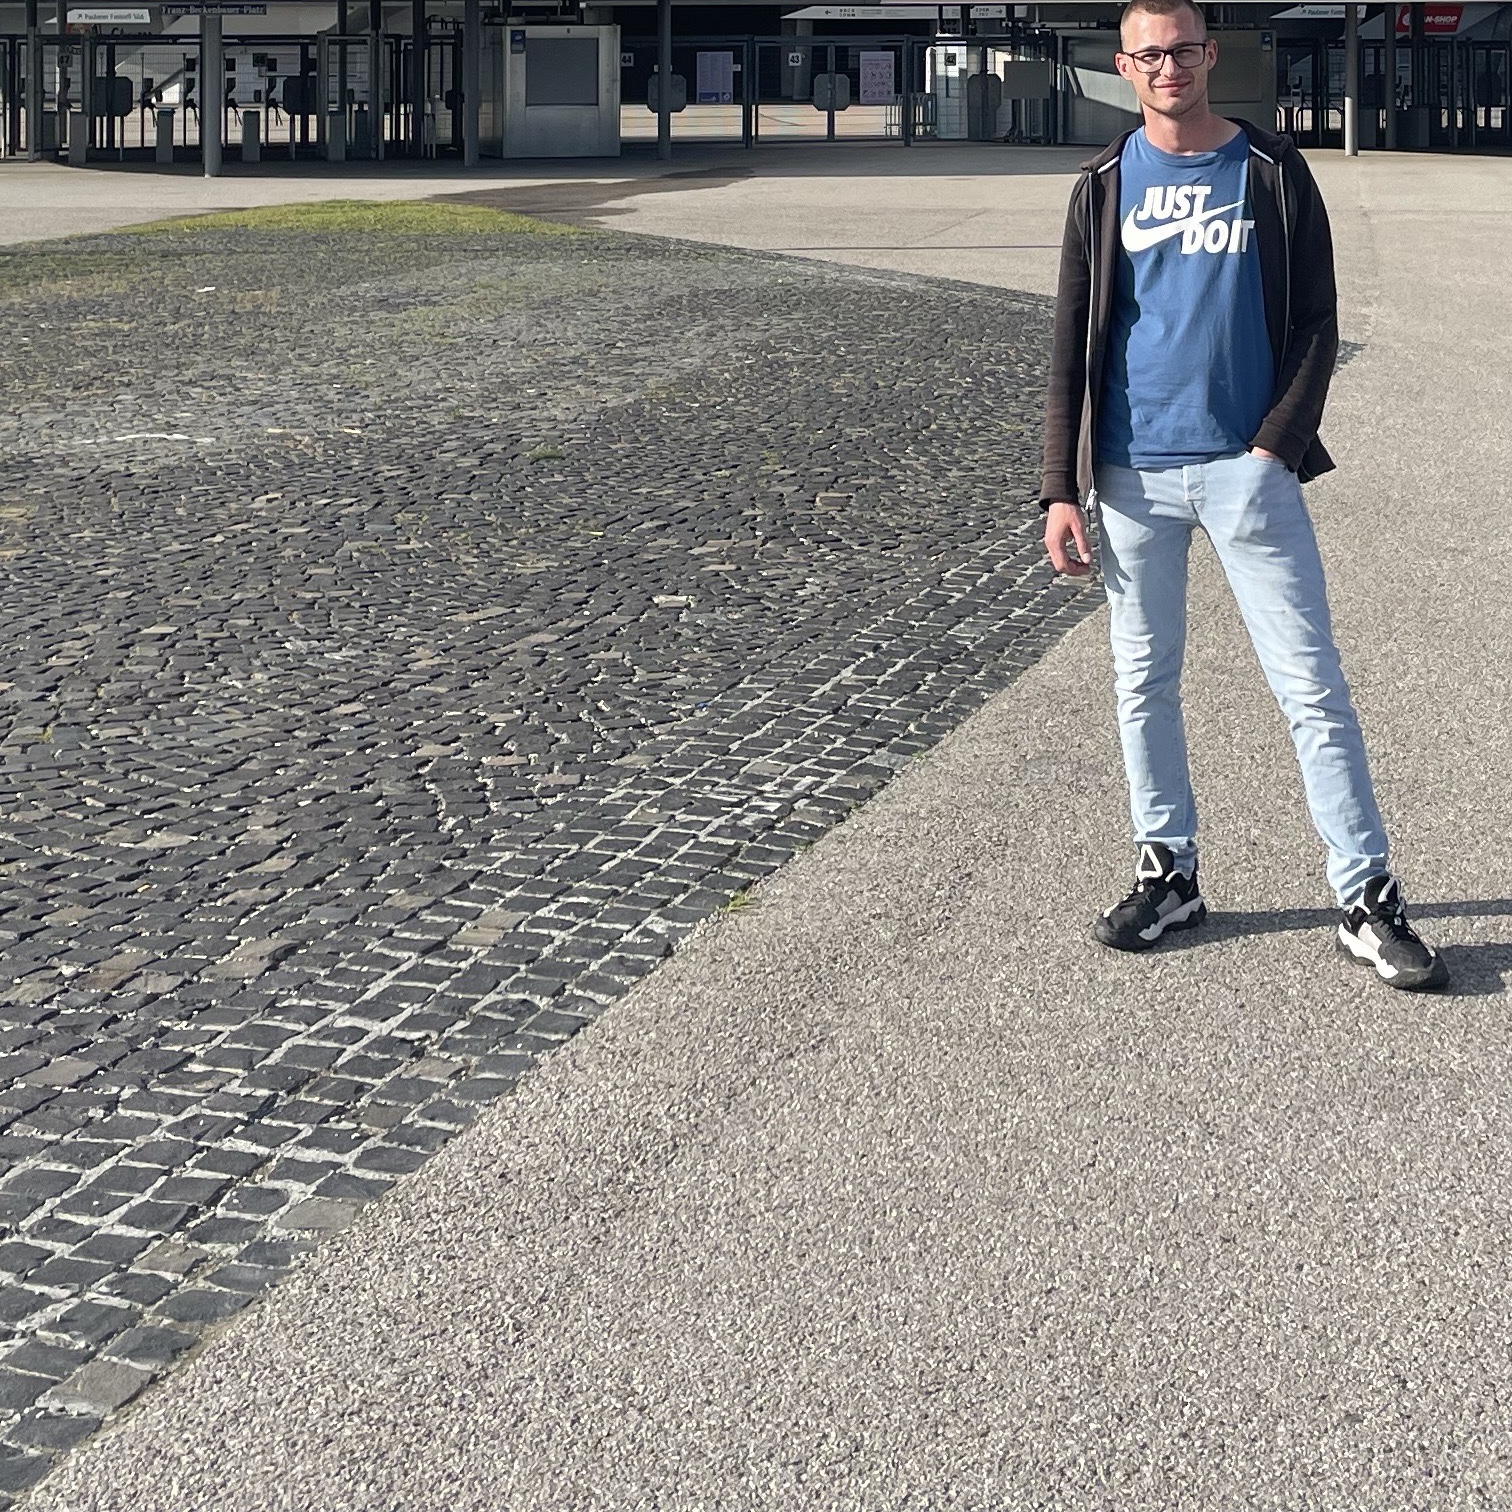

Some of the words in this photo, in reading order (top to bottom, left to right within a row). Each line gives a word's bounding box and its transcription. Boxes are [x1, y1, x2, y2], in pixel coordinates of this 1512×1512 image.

[621, 55, 632, 64] 44
[789, 55, 800, 64] 43
[1136, 185, 1212, 221] JUST
